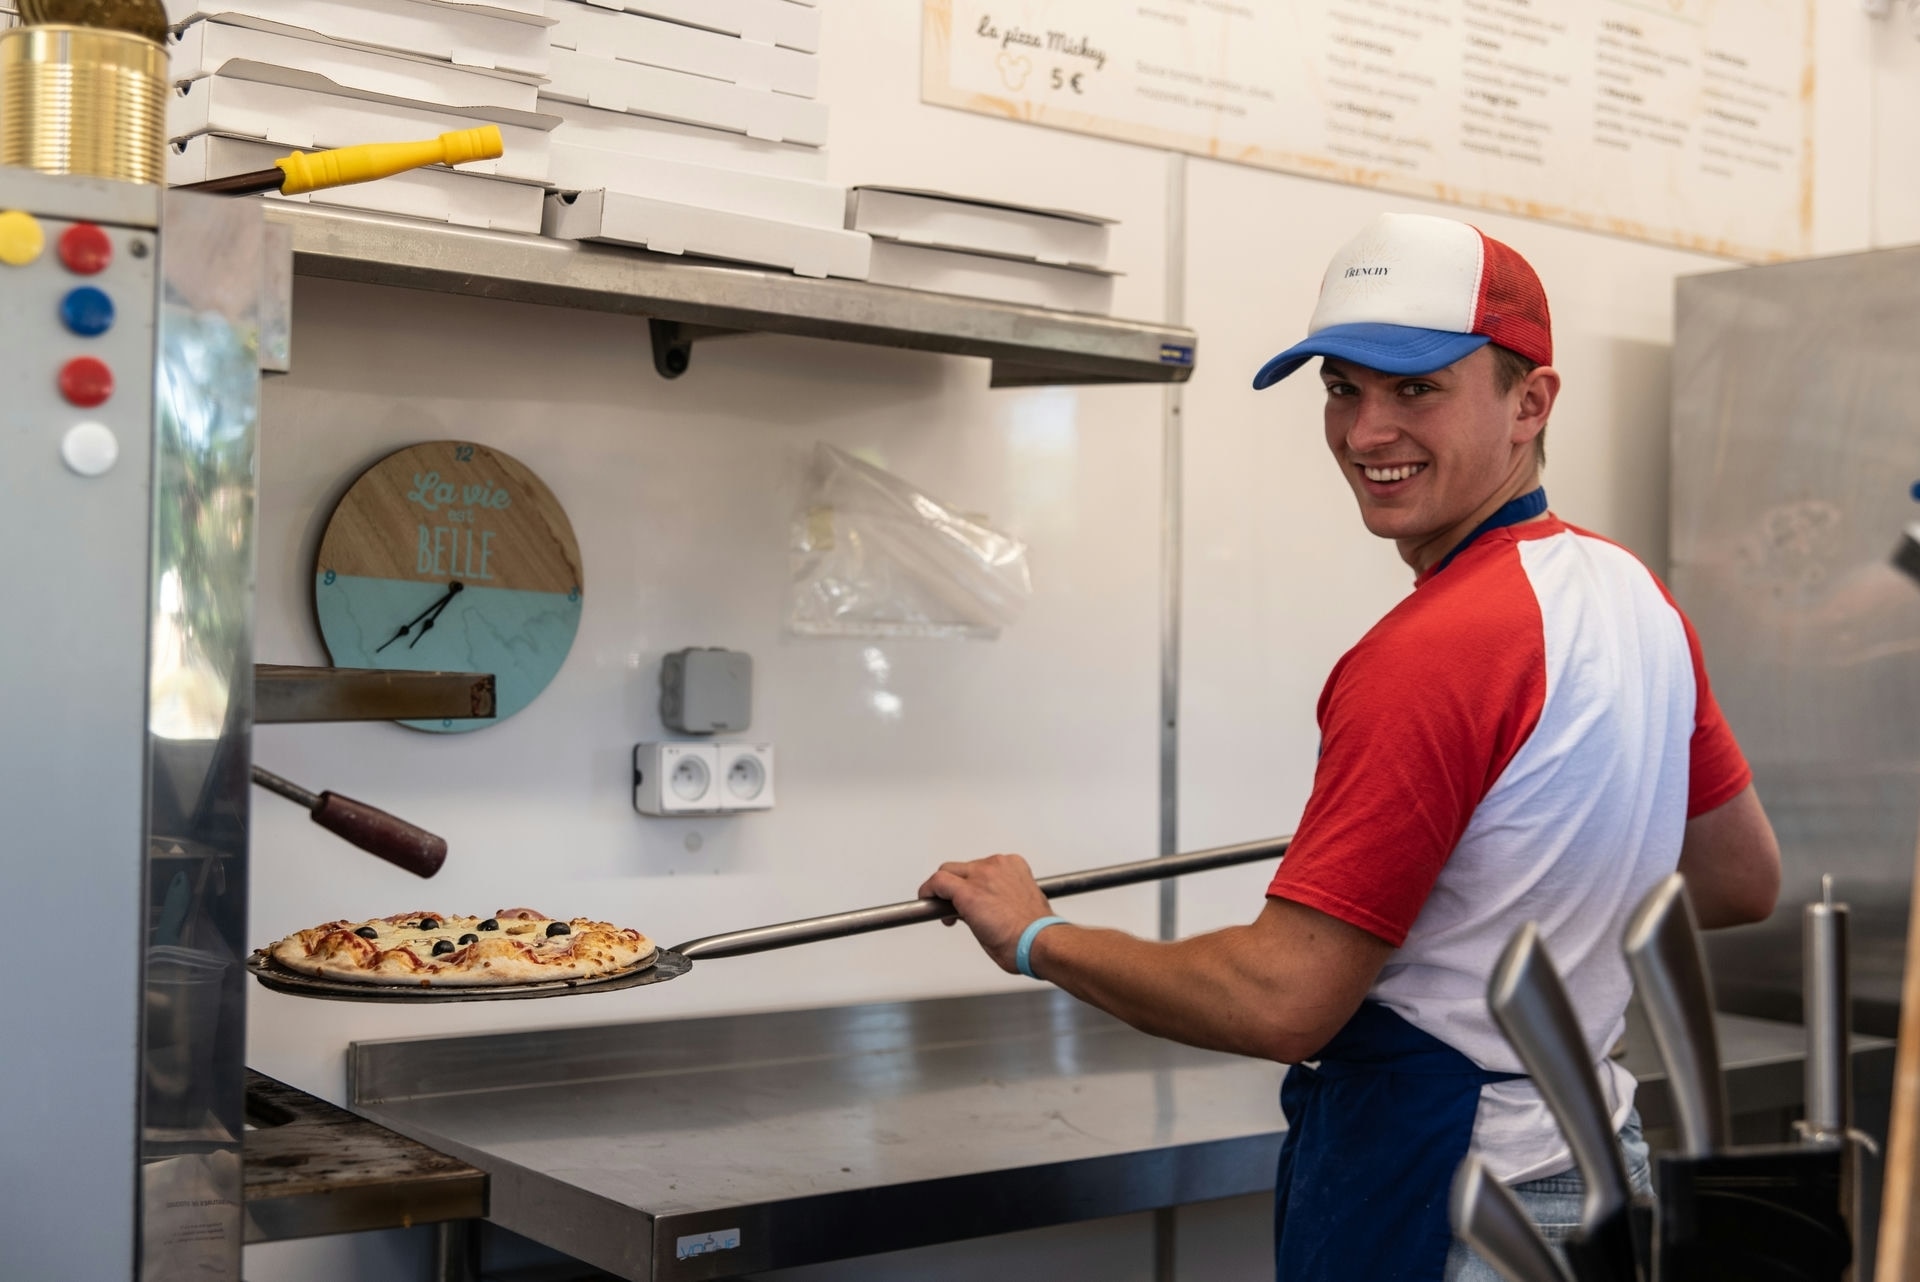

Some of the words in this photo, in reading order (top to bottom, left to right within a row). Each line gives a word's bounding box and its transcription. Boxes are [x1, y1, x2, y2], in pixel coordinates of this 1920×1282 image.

[1001, 26, 1042, 49] pizza
[1046, 30, 1107, 70] Mickey
[1051, 68, 1063, 89] 5
[1070, 73, 1084, 94] €
[455, 446, 474, 462] 12
[408, 471, 457, 511] La
[463, 480, 511, 510] vie
[417, 525, 495, 579] BELLE
[324, 569, 337, 586] 9
[568, 586, 580, 603] 3
